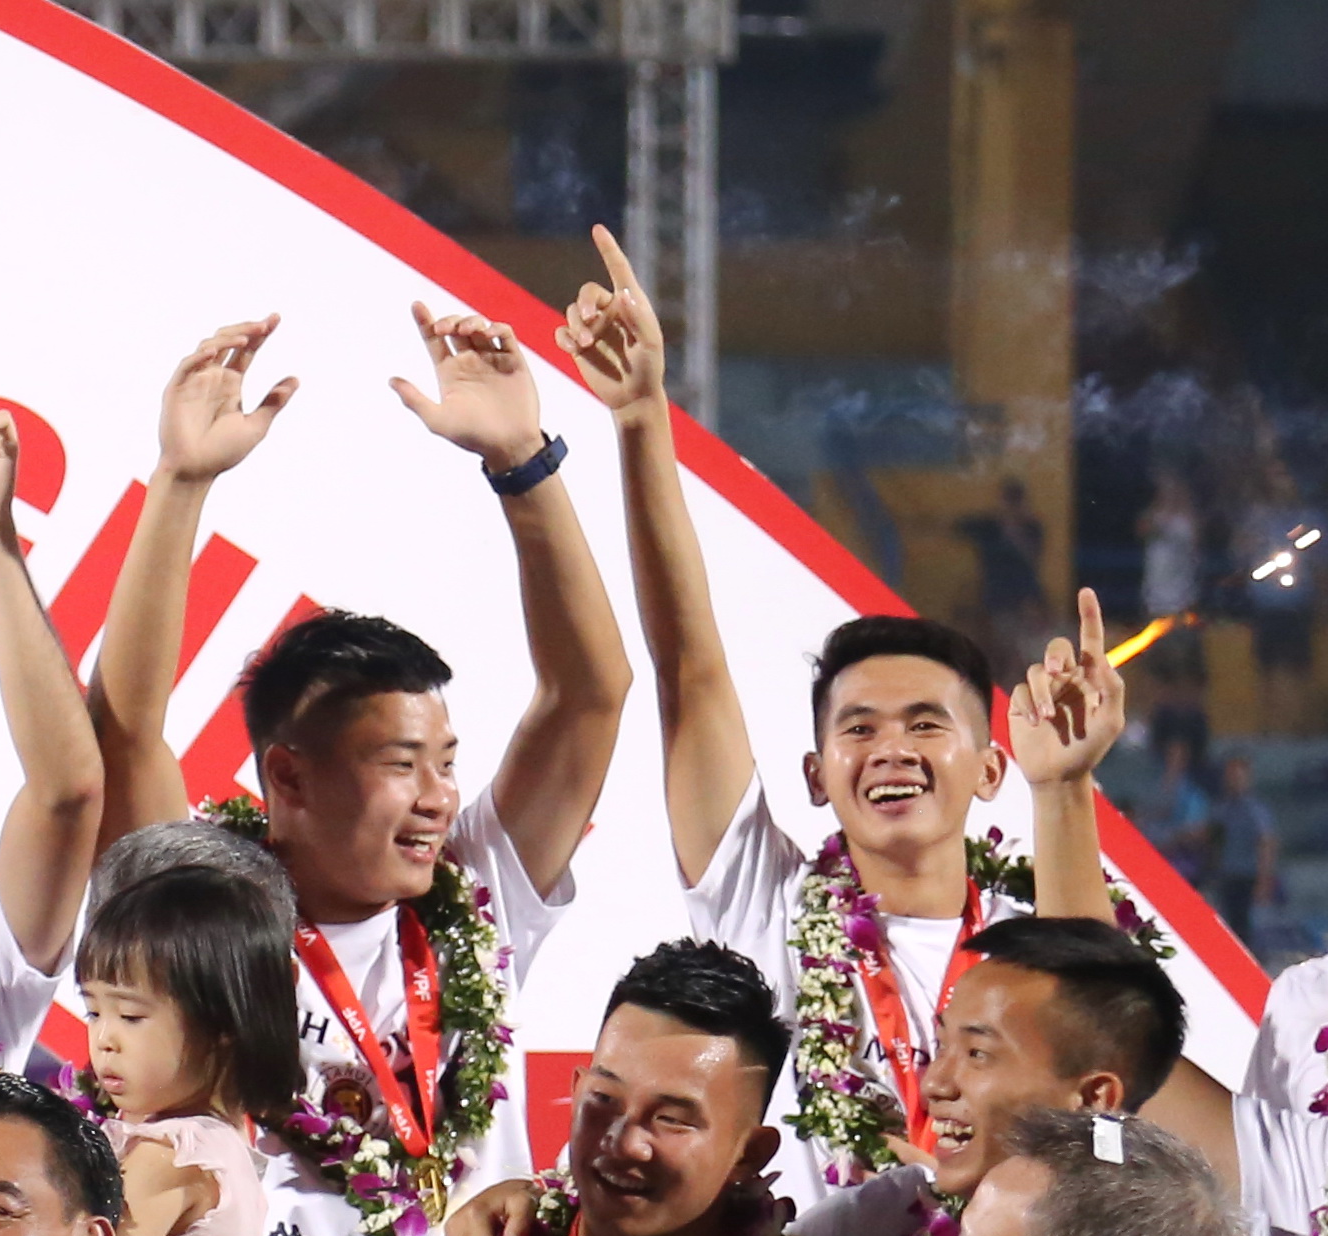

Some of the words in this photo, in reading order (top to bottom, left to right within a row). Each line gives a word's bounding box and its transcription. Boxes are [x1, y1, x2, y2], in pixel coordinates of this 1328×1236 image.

[413, 968, 432, 1002] VPF
[342, 1006, 367, 1042] VPF
[391, 1104, 413, 1140] VPF
